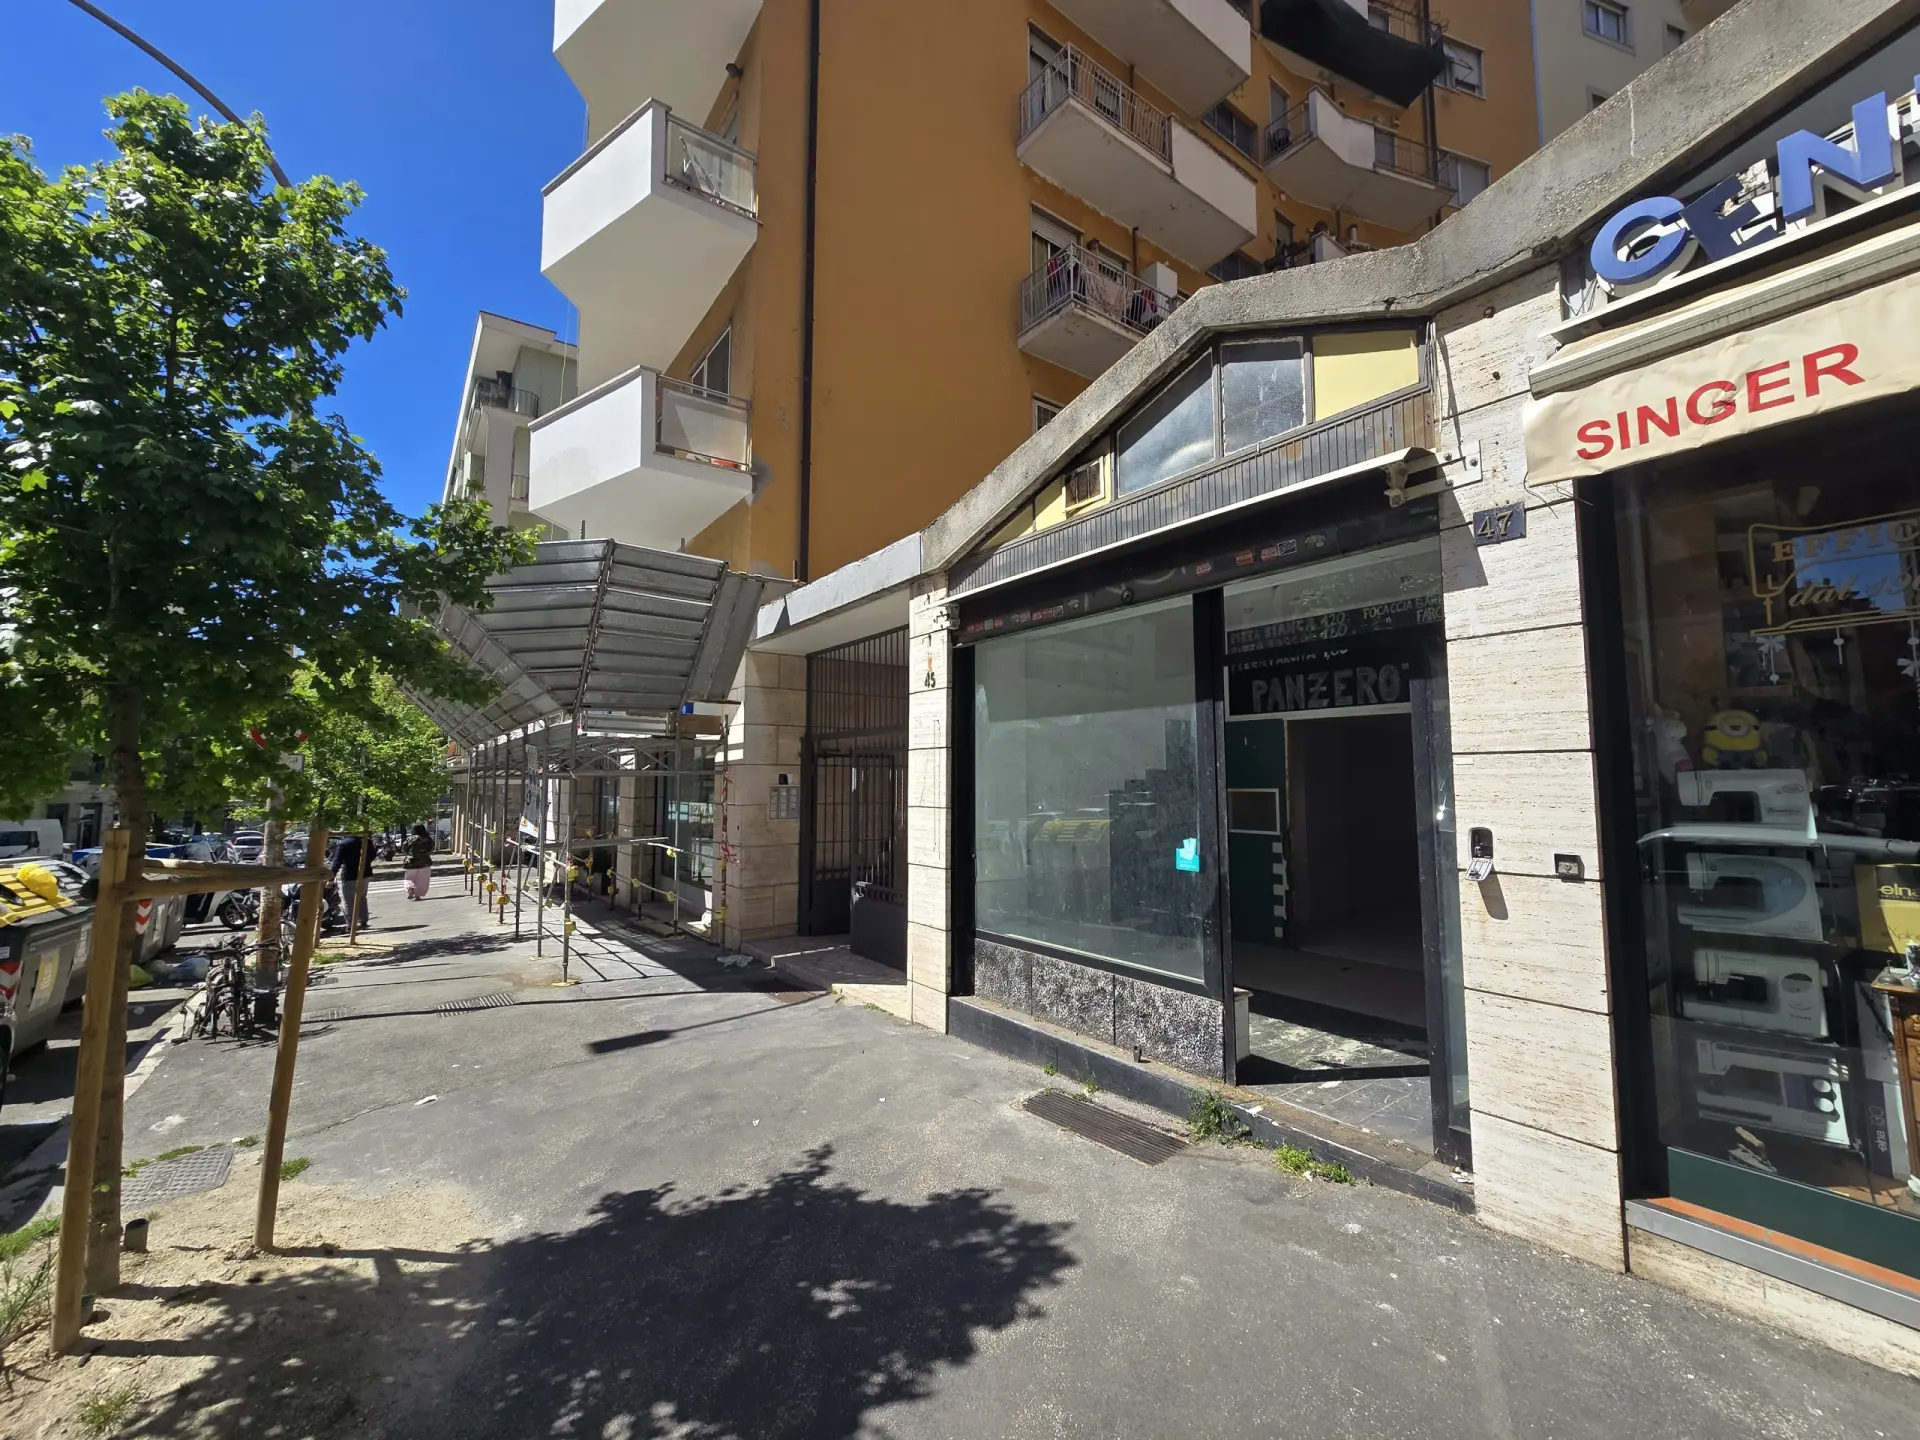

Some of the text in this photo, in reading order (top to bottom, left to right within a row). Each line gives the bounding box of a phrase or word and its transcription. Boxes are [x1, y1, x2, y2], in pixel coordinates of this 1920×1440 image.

[1590, 74, 1920, 285] CEN
[1576, 342, 1867, 460] SINGER
[1477, 510, 1513, 538] 47
[1788, 572, 1860, 607] dal
[1363, 599, 1413, 620] FOCACCIA
[924, 671, 936, 688] 45
[1252, 661, 1409, 711] PANZERO
